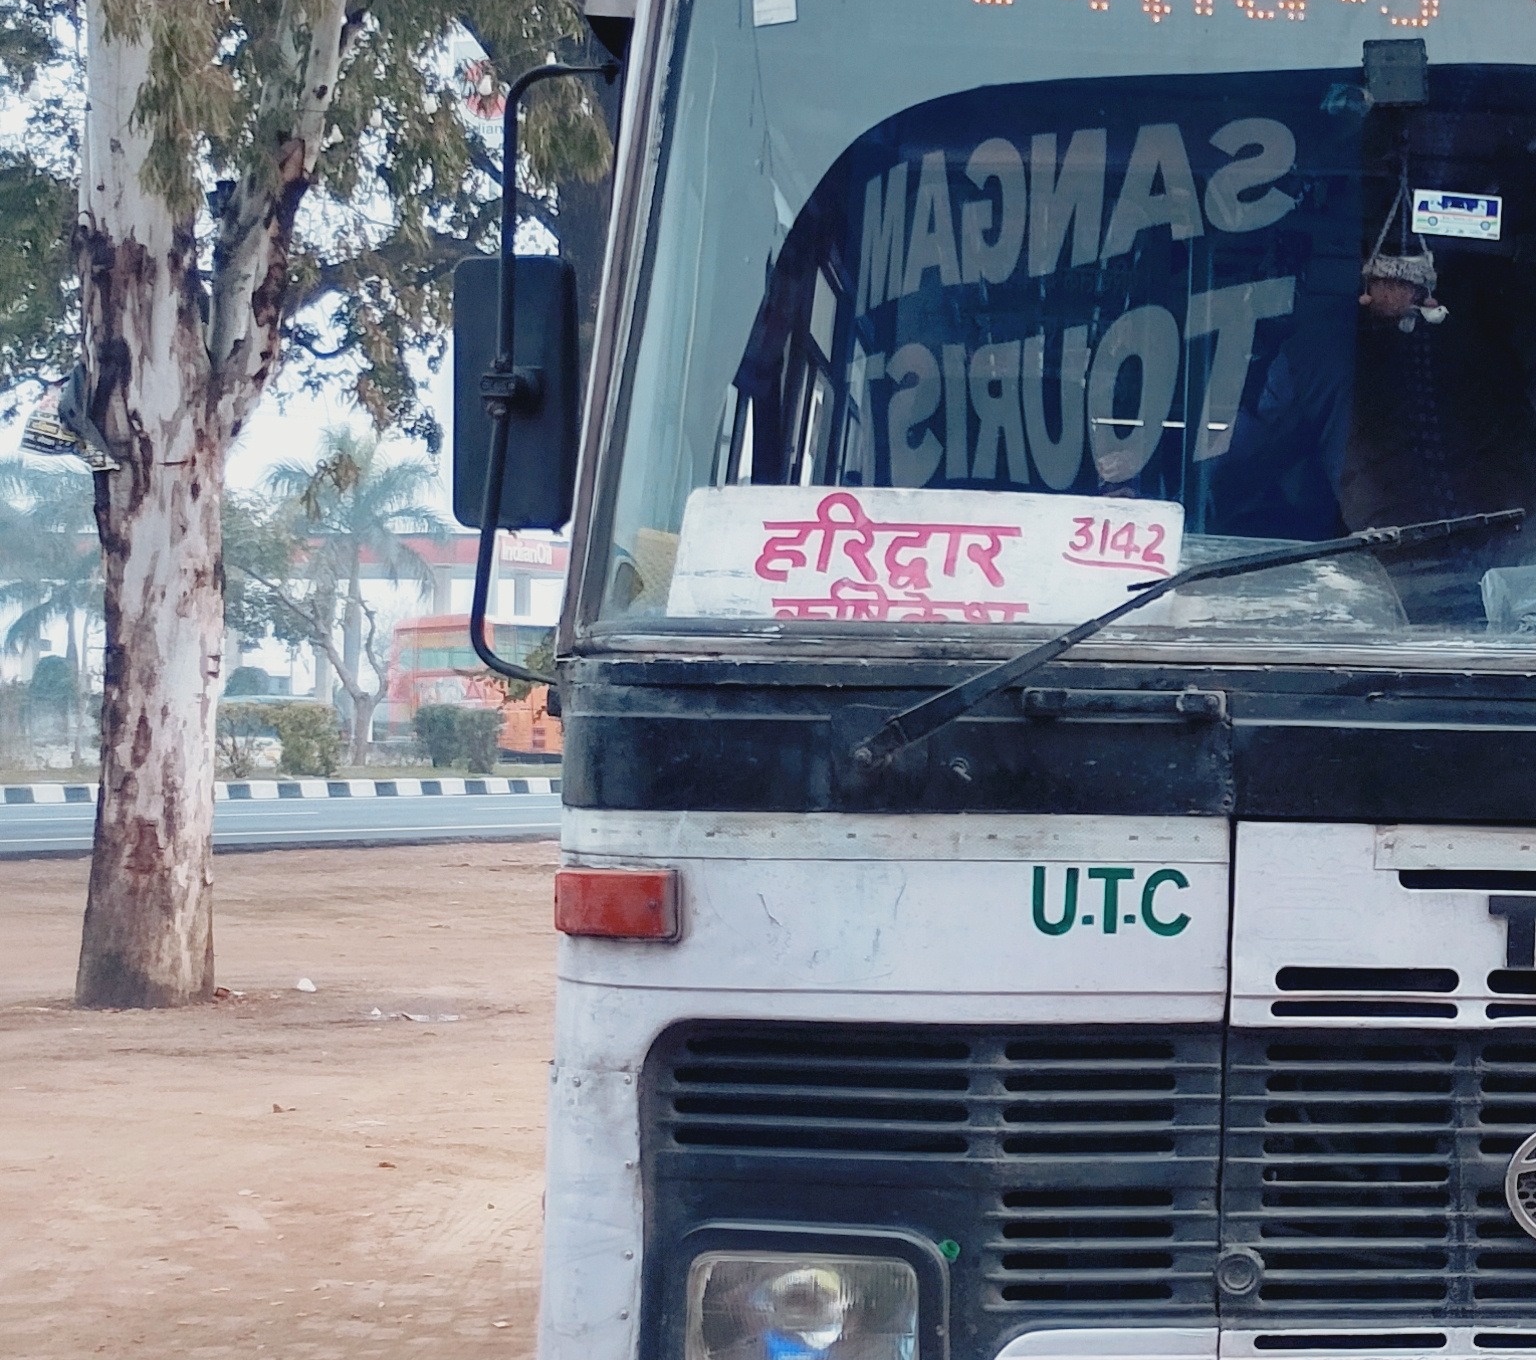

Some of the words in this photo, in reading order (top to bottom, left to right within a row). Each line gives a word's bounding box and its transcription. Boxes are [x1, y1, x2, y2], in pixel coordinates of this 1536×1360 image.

[755, 492, 1021, 589] हरिद्वार
[1069, 516, 1165, 565] 3142
[1032, 865, 1191, 936] U.T.C
